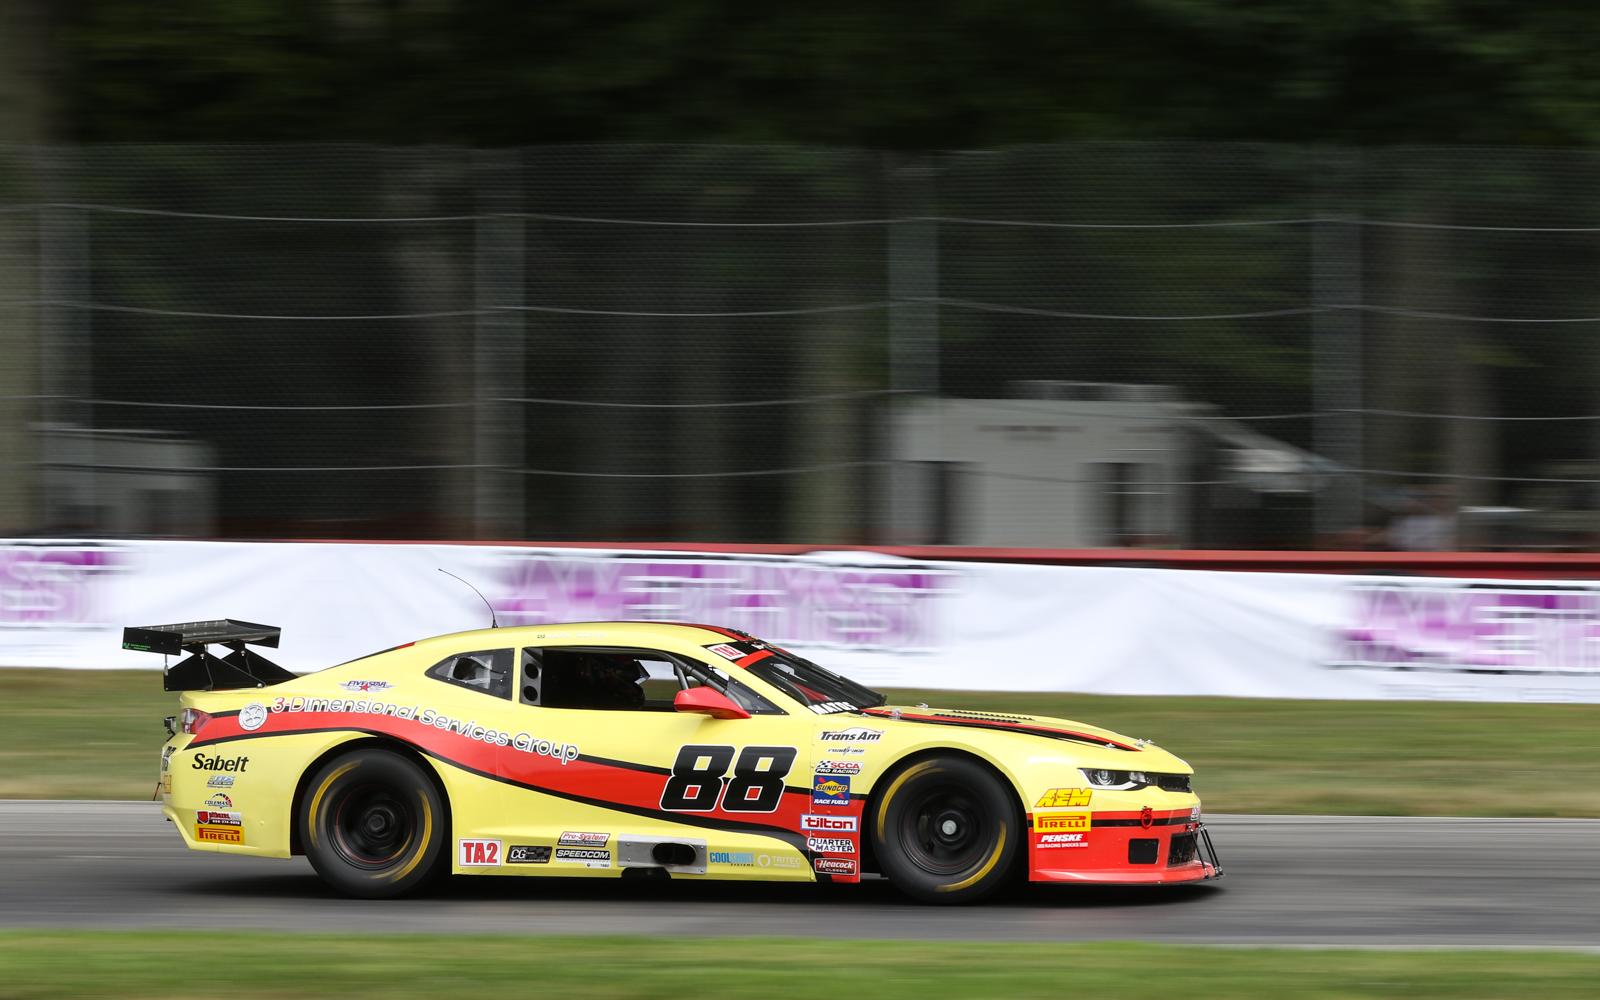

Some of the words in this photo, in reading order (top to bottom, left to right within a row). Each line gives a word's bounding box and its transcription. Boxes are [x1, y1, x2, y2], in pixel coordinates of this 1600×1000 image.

[271, 696, 417, 720] 3-Dimensional
[420, 709, 508, 746] Services
[512, 732, 579, 765] Group
[820, 731, 856, 741] Trans
[857, 731, 881, 740] Am
[192, 753, 249, 772] Sabelt
[659, 744, 798, 813] 88
[1034, 787, 1093, 808] AEM
[805, 817, 853, 829] tilton
[1038, 815, 1087, 829] PIRELLI
[198, 827, 240, 842] PIRELLI
[563, 833, 607, 842] Pro-System
[1041, 833, 1084, 842] PENSKE
[808, 838, 851, 847] QUARTER
[463, 842, 497, 864] TA2
[511, 849, 527, 859] CG
[820, 860, 853, 868] Heacock
